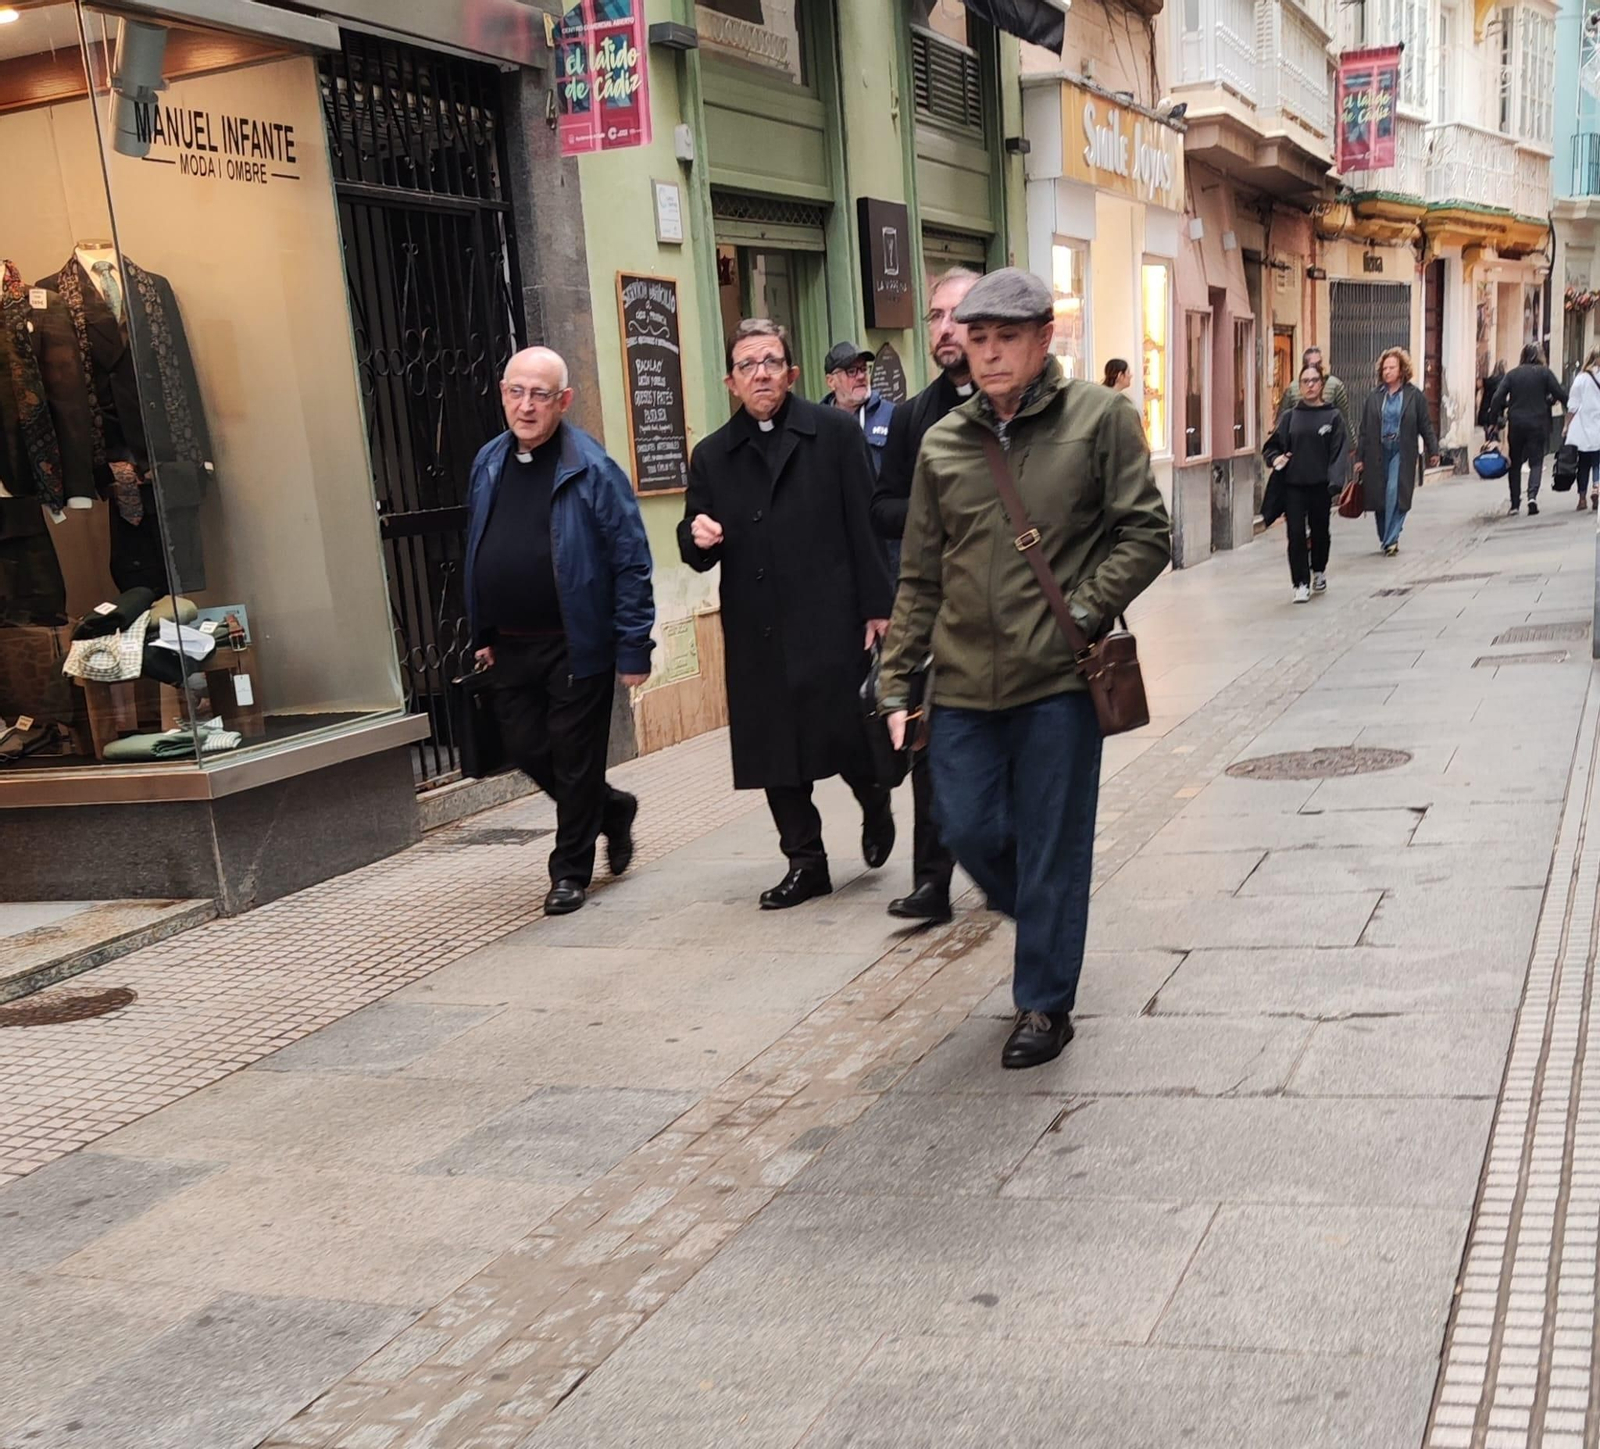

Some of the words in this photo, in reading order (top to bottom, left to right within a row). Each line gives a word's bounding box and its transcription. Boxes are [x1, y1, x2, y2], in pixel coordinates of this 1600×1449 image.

[589, 36, 640, 73] latido
[565, 77, 589, 102] de
[594, 71, 642, 102] Cádiz
[134, 101, 218, 153] MANUEL
[221, 115, 296, 163] INFANTE
[1083, 101, 1128, 178] Smile
[1132, 122, 1172, 200] Joyas
[180, 153, 216, 178] MODA
